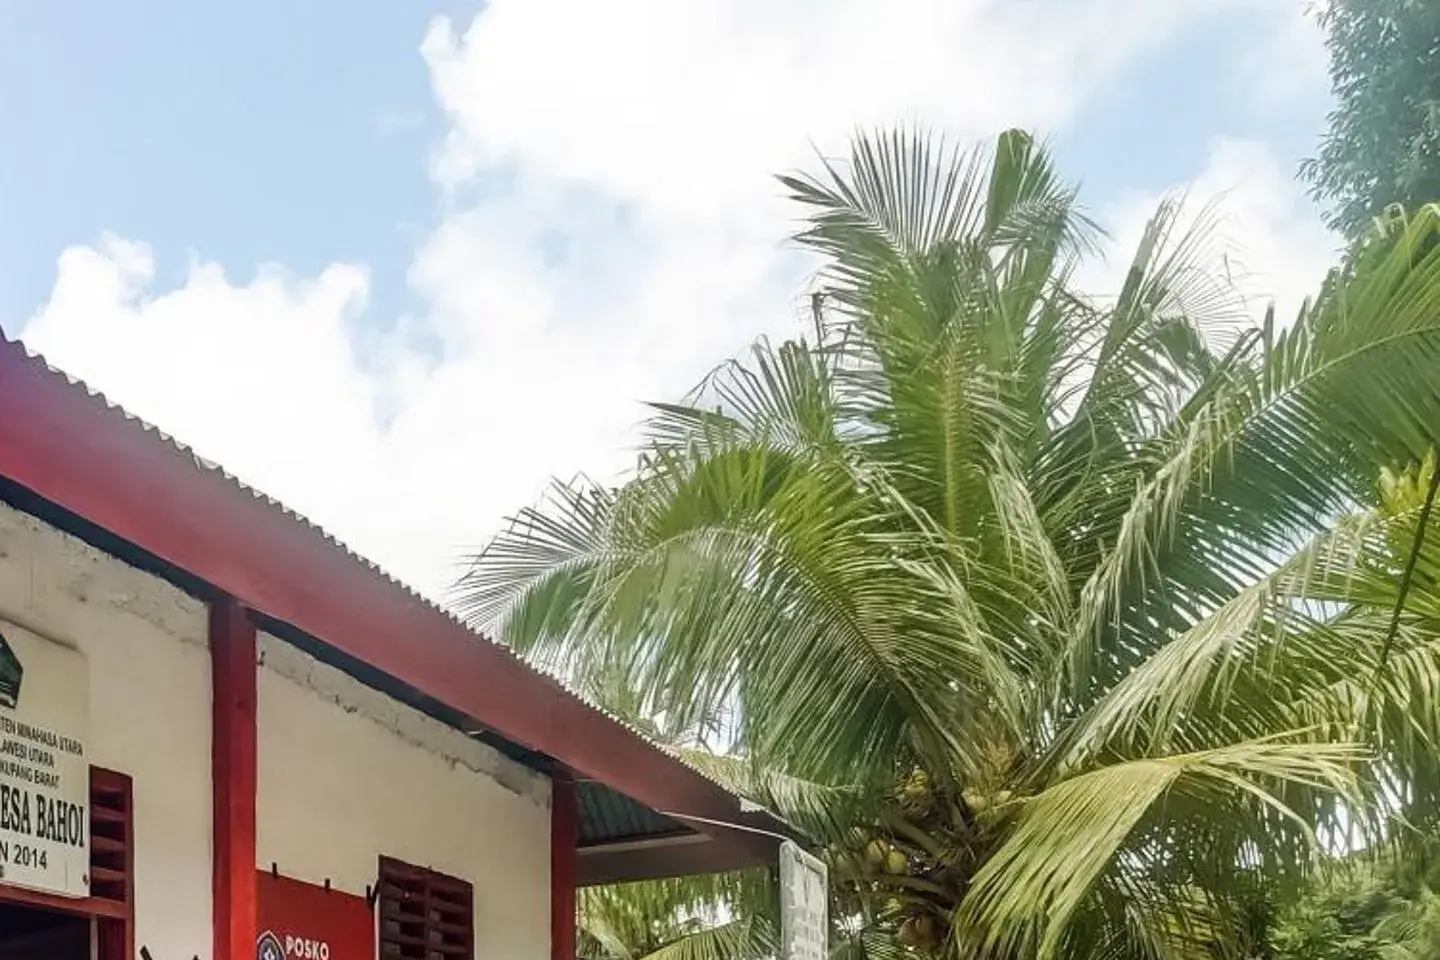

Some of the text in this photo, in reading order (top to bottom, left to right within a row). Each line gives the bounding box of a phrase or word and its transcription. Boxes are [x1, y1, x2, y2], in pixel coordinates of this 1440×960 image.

[17, 721, 59, 749] MINAHASA
[59, 735, 84, 757] UTARA
[28, 747, 55, 769] UTARA
[35, 796, 85, 848] BAHOI
[13, 843, 48, 871] 2014
